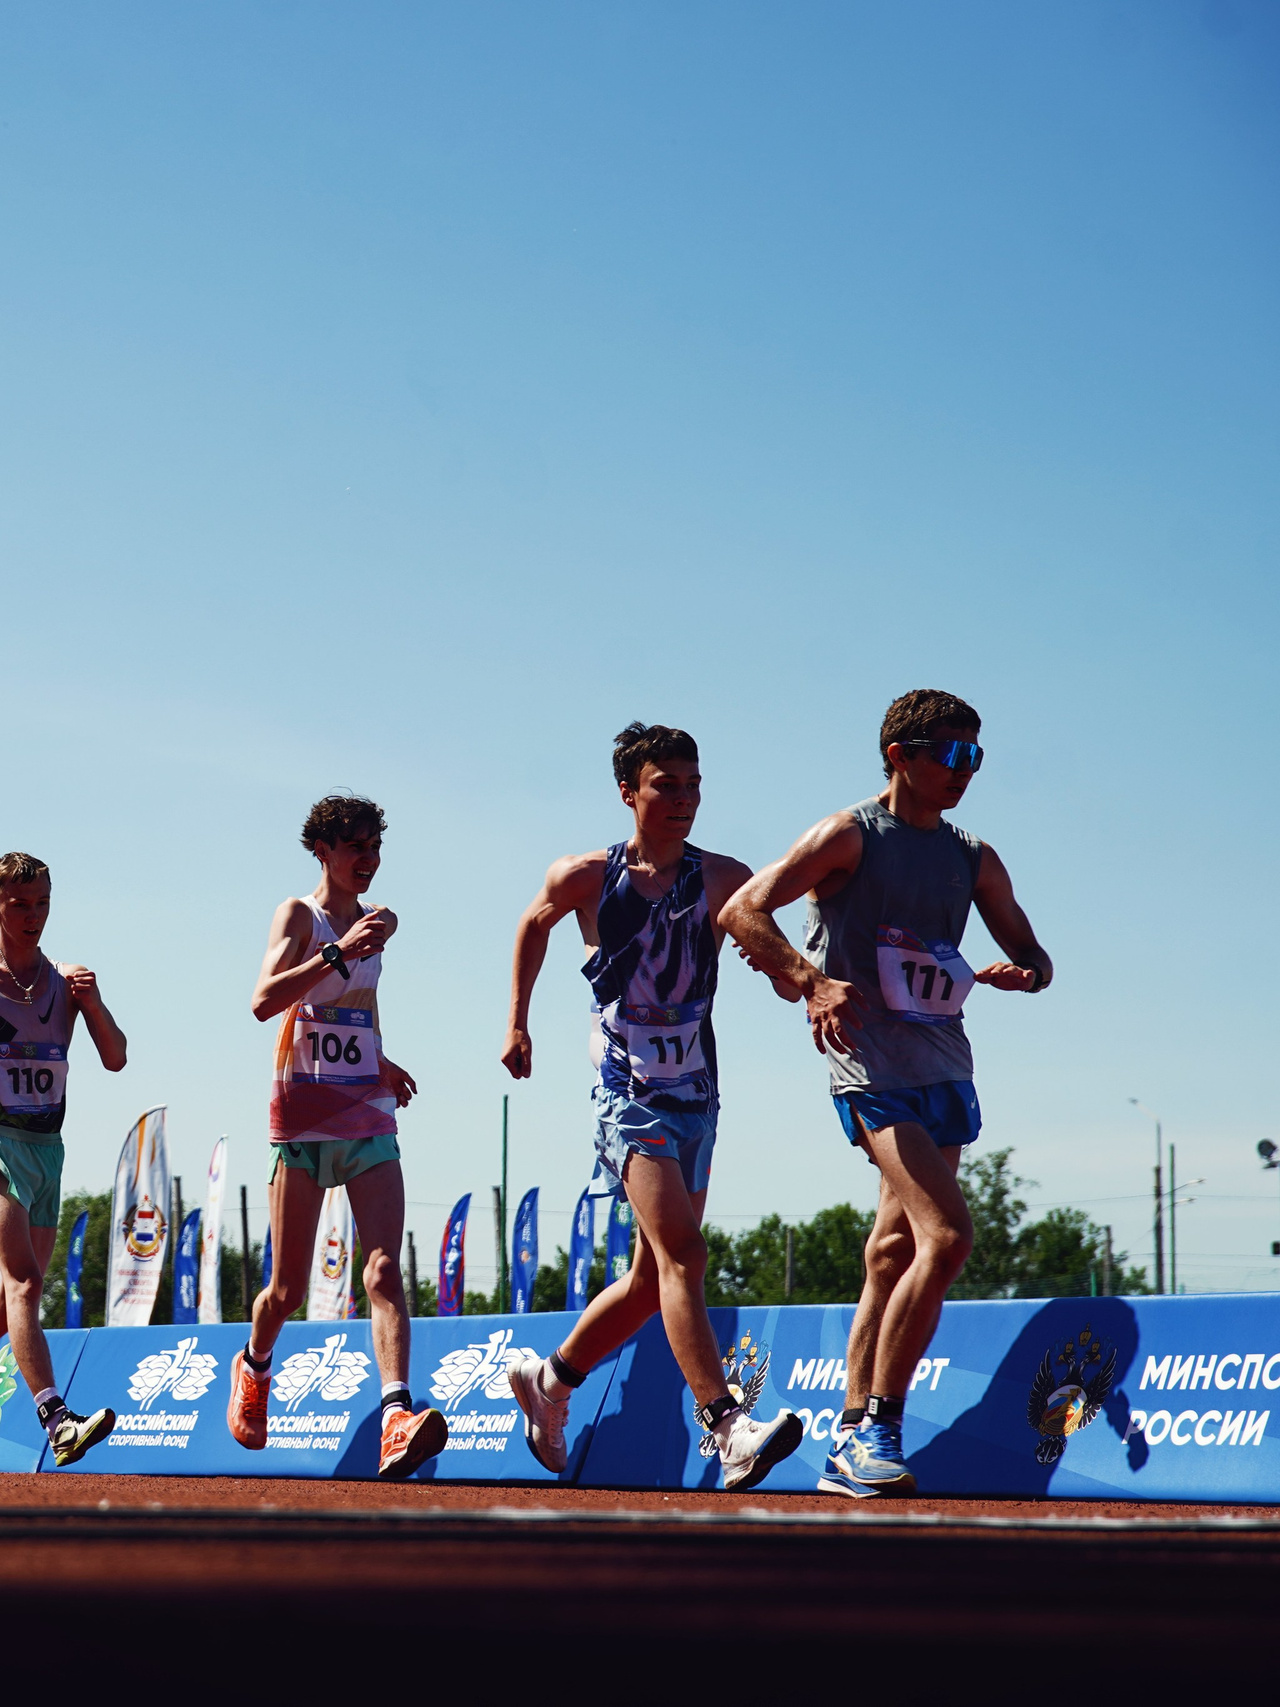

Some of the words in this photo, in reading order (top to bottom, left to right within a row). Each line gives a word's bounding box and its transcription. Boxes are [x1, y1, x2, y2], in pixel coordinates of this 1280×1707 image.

[306, 1031, 362, 1066] 106
[6, 1067, 54, 1095] 110
[787, 1358, 951, 1392] МИНРТ
[1139, 1353, 1280, 1391] МИНСПО
[113, 1410, 199, 1431] РОССИЙСКИЙ
[266, 1411, 351, 1433] ОССИЙСКИЙ
[444, 1409, 518, 1433] СИЙСКИЙ
[1121, 1409, 1271, 1447] РОССИИ
[108, 1433, 164, 1446] СПОРТИВНЫЙ
[163, 1434, 190, 1449] ФОНД
[265, 1434, 313, 1449] РТИВНЫЙ
[312, 1436, 341, 1451] ФОНД
[475, 1437, 508, 1452] ФОНД
